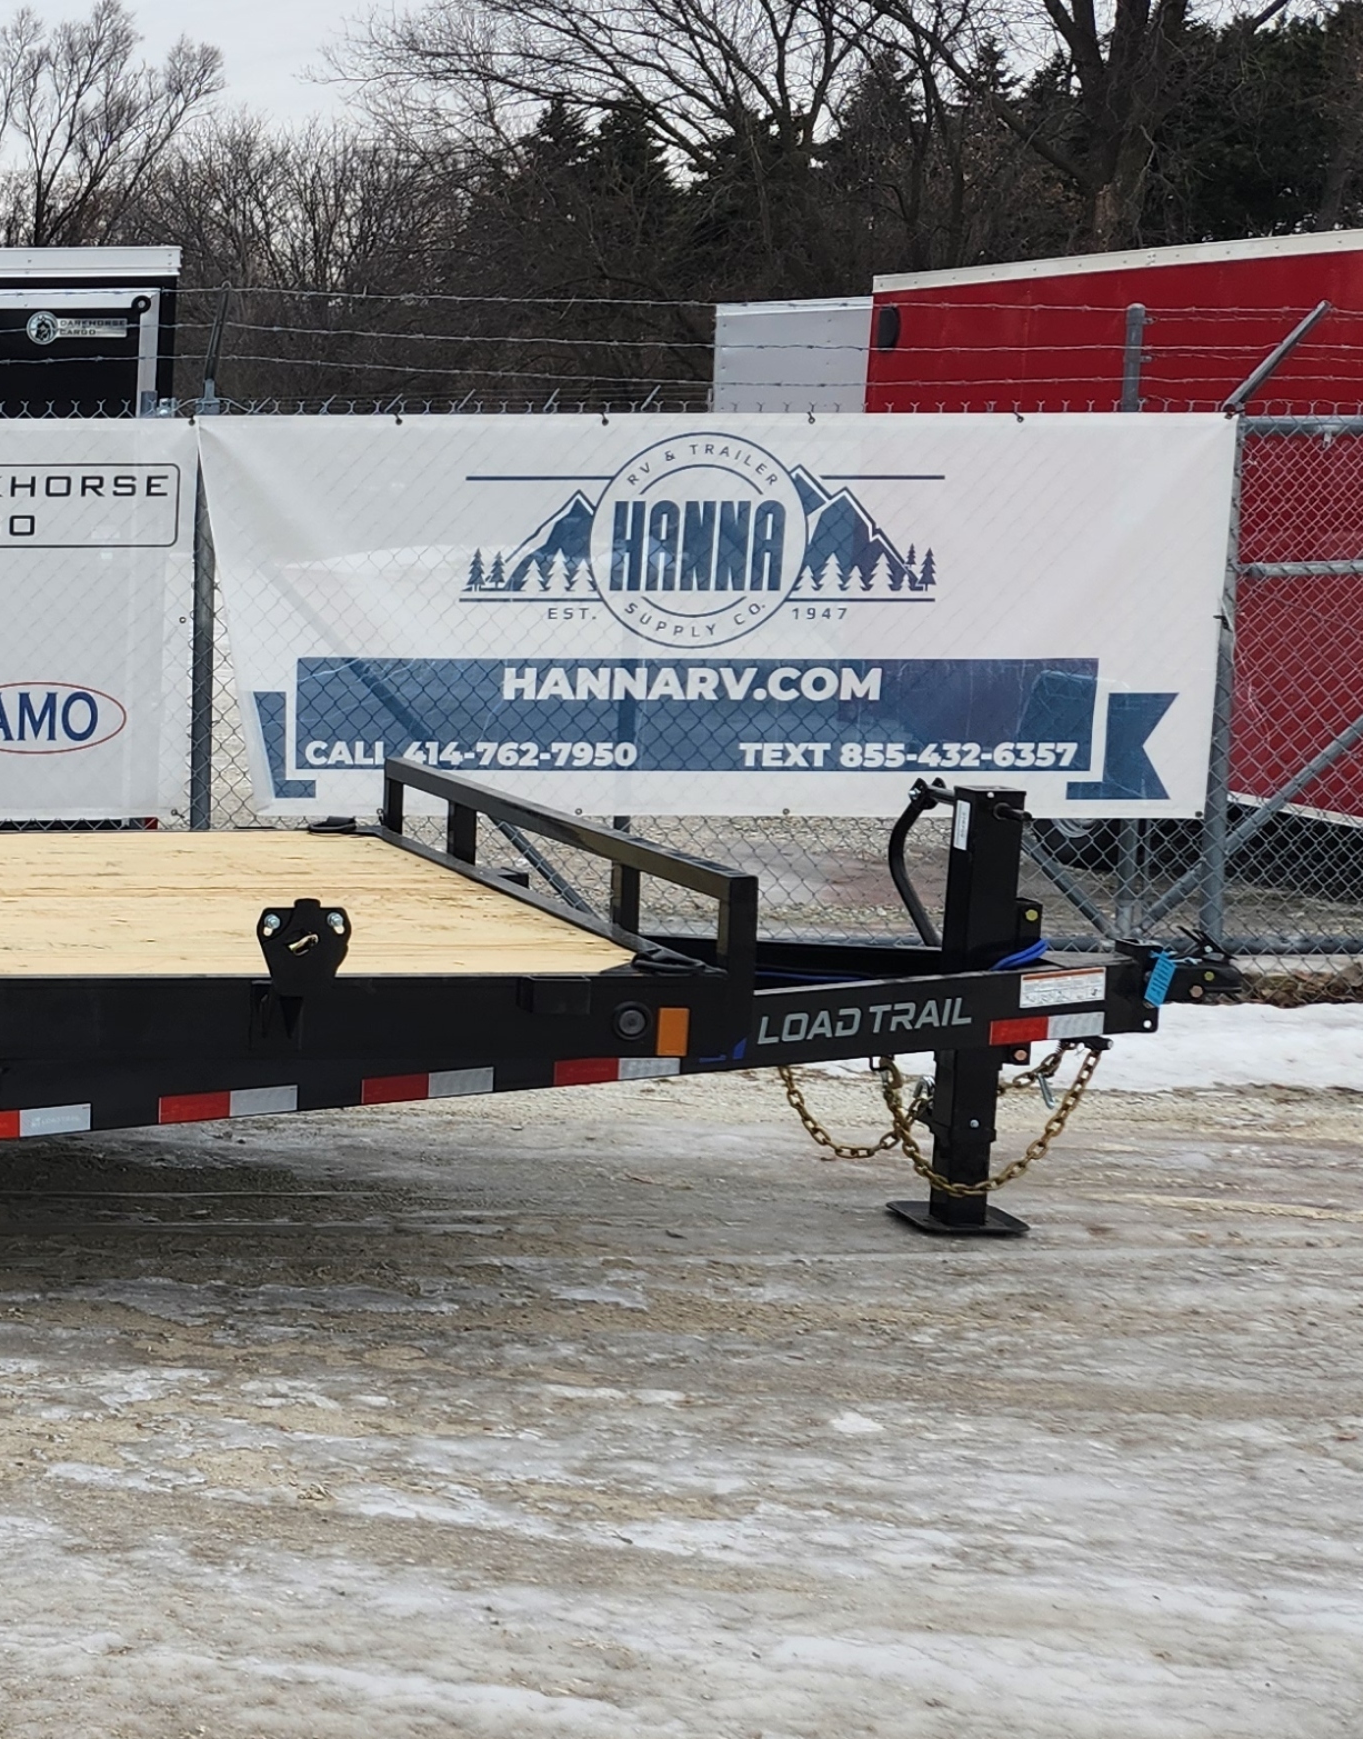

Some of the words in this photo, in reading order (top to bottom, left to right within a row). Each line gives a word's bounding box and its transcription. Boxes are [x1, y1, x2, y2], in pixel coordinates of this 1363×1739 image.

[627, 463, 651, 486] RV
[664, 450, 676, 462] &
[689, 444, 779, 486] TRAILER
[609, 500, 786, 591] HANNA
[547, 607, 598, 620] EST.
[792, 608, 848, 620] 1947
[624, 602, 716, 637] SUPPLY
[733, 602, 766, 626] CO.
[503, 666, 883, 701] HANNARV.COM
[403, 741, 638, 767] 414-762-7950
[739, 742, 831, 768] TEXT
[840, 742, 1078, 768] 855-432-6357
[757, 1007, 861, 1045] LOAD
[869, 998, 972, 1034] TRAIL
